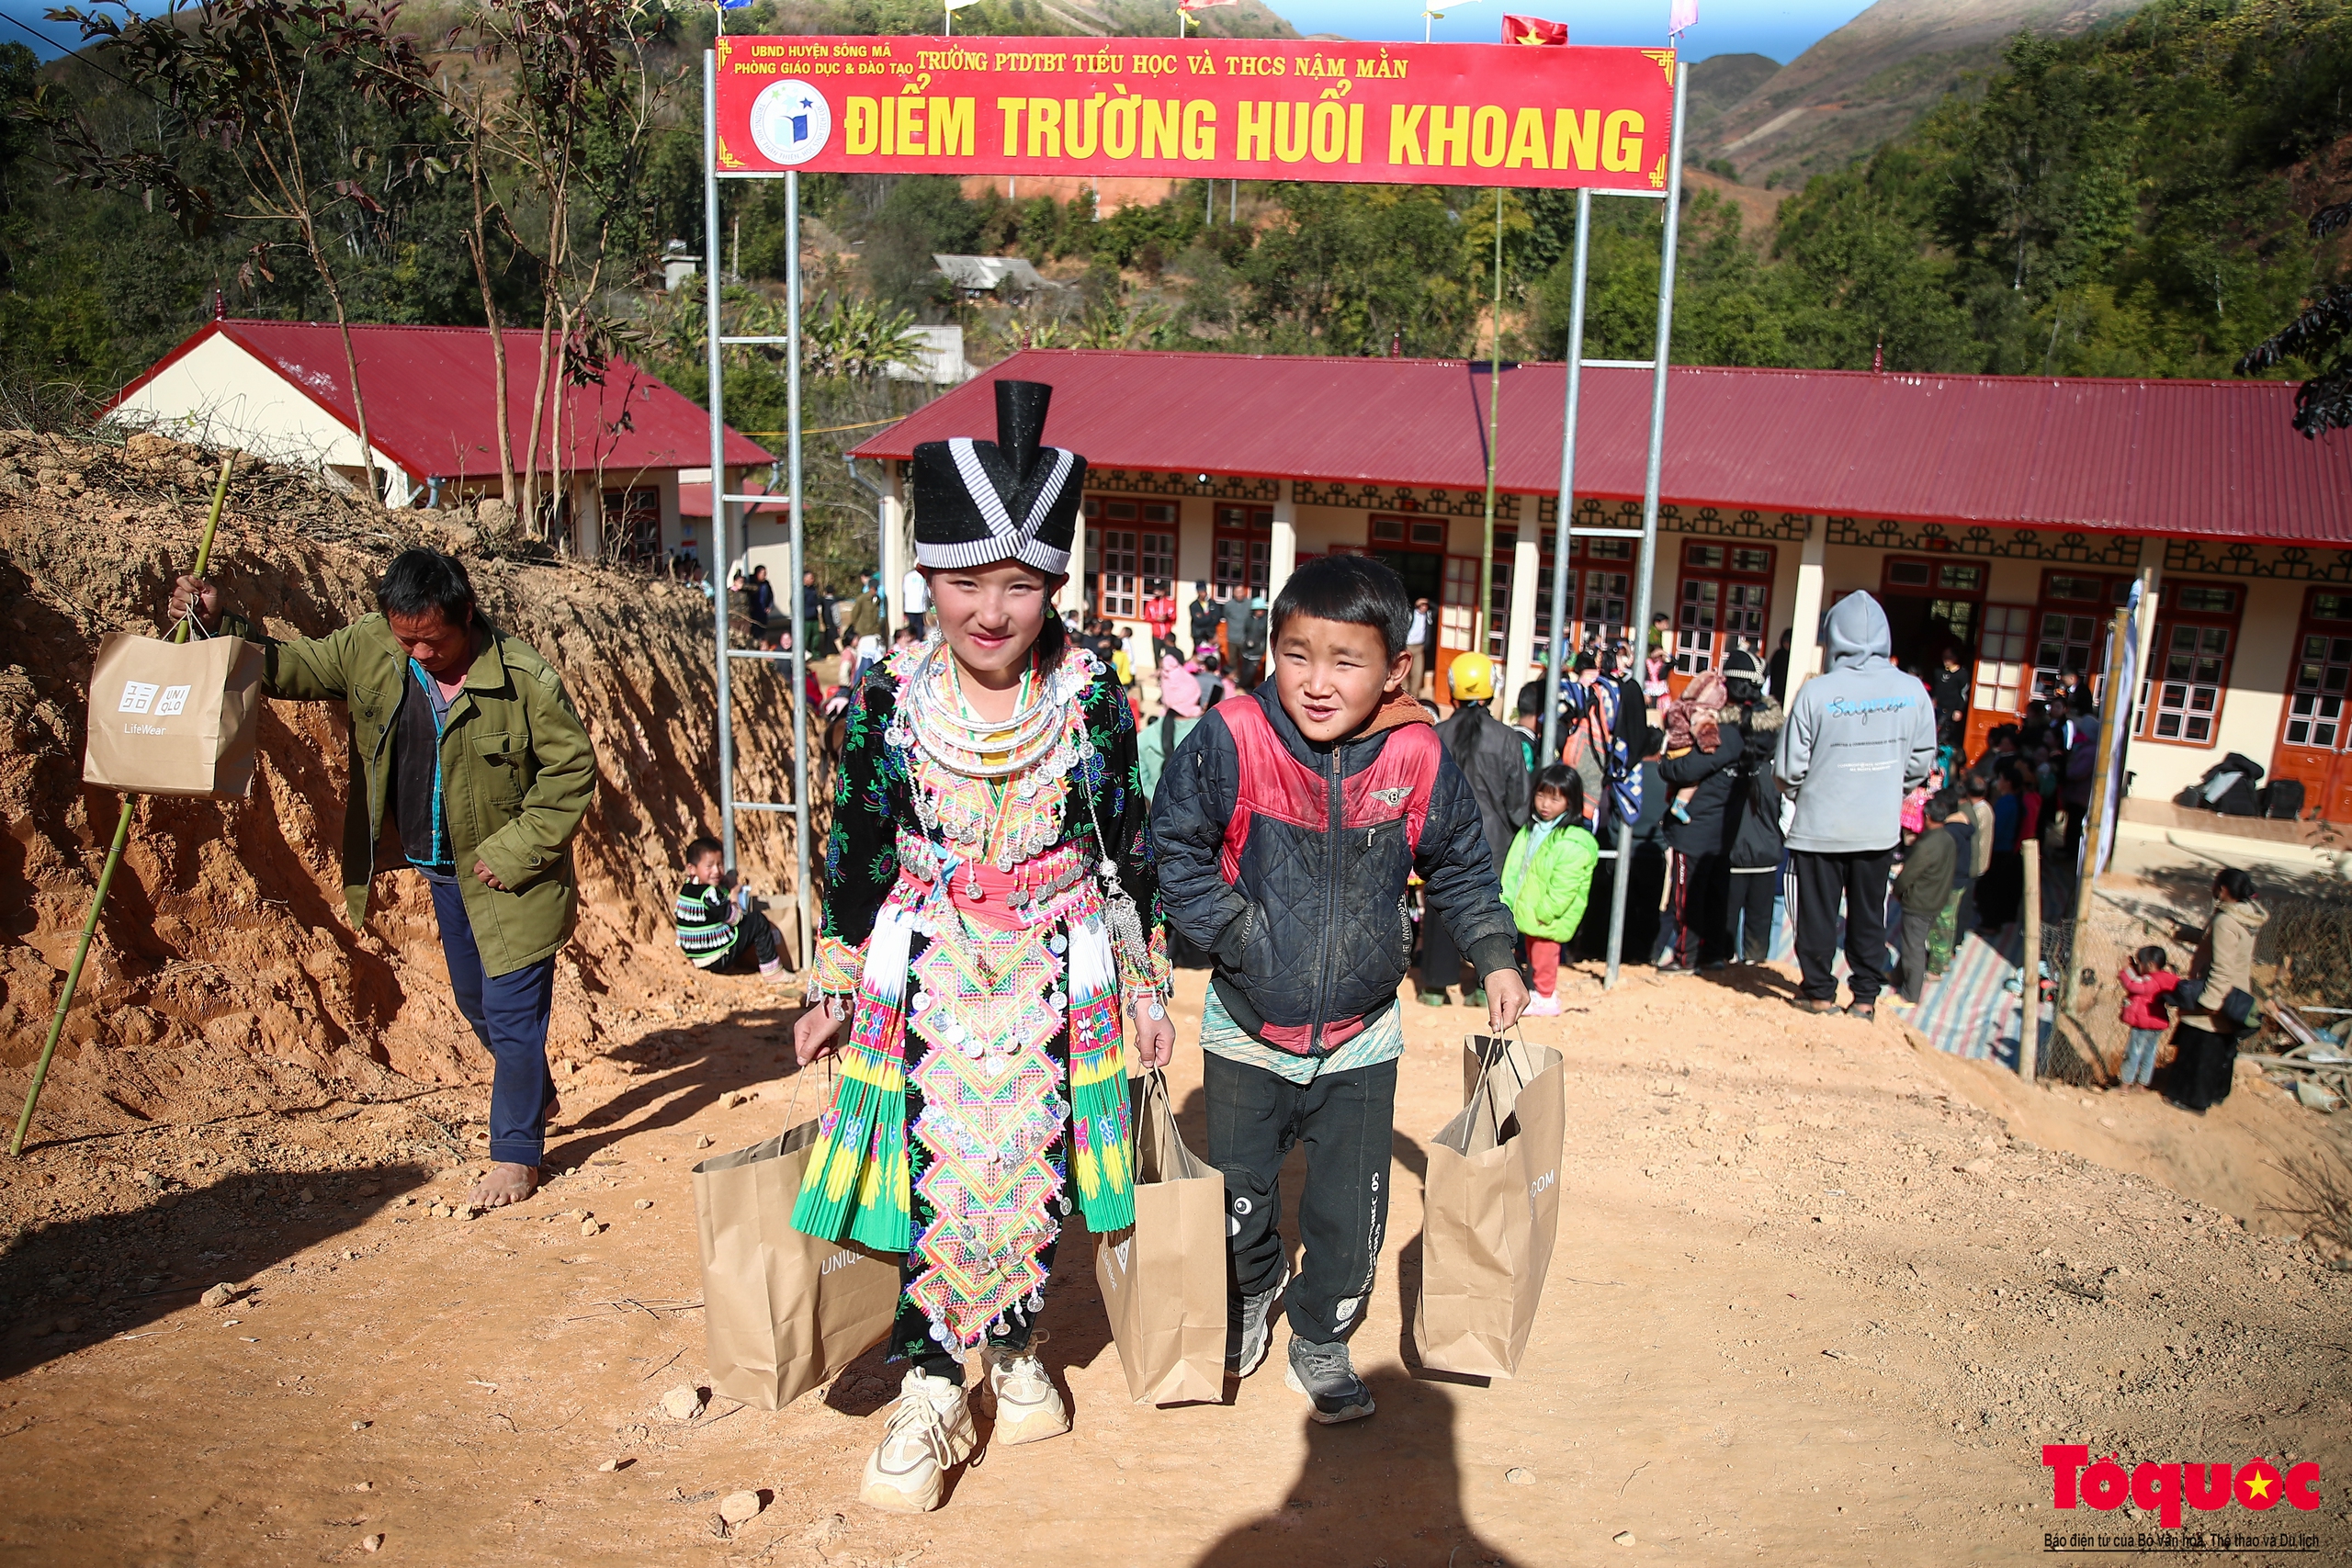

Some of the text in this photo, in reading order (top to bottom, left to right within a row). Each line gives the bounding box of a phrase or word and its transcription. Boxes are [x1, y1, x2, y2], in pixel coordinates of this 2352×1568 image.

[752, 41, 892, 60] UBND HUYỆN SÔNG MÃ
[734, 60, 914, 77] PHÒNG GIÁO DỤC & ĐÀO TẠO
[916, 43, 989, 72] TRƯỜNG
[994, 53, 1067, 72] PTDTBT
[1131, 53, 1178, 79] HỌC
[1186, 49, 1216, 75] VÀ
[1225, 56, 1286, 76] THCS
[1294, 52, 1347, 82] NẬM
[843, 73, 1645, 173] ĐIỂM TRƯỜNG HUỔI KHOANG
[166, 689, 186, 700] UNI
[124, 723, 167, 736] LifeWear
